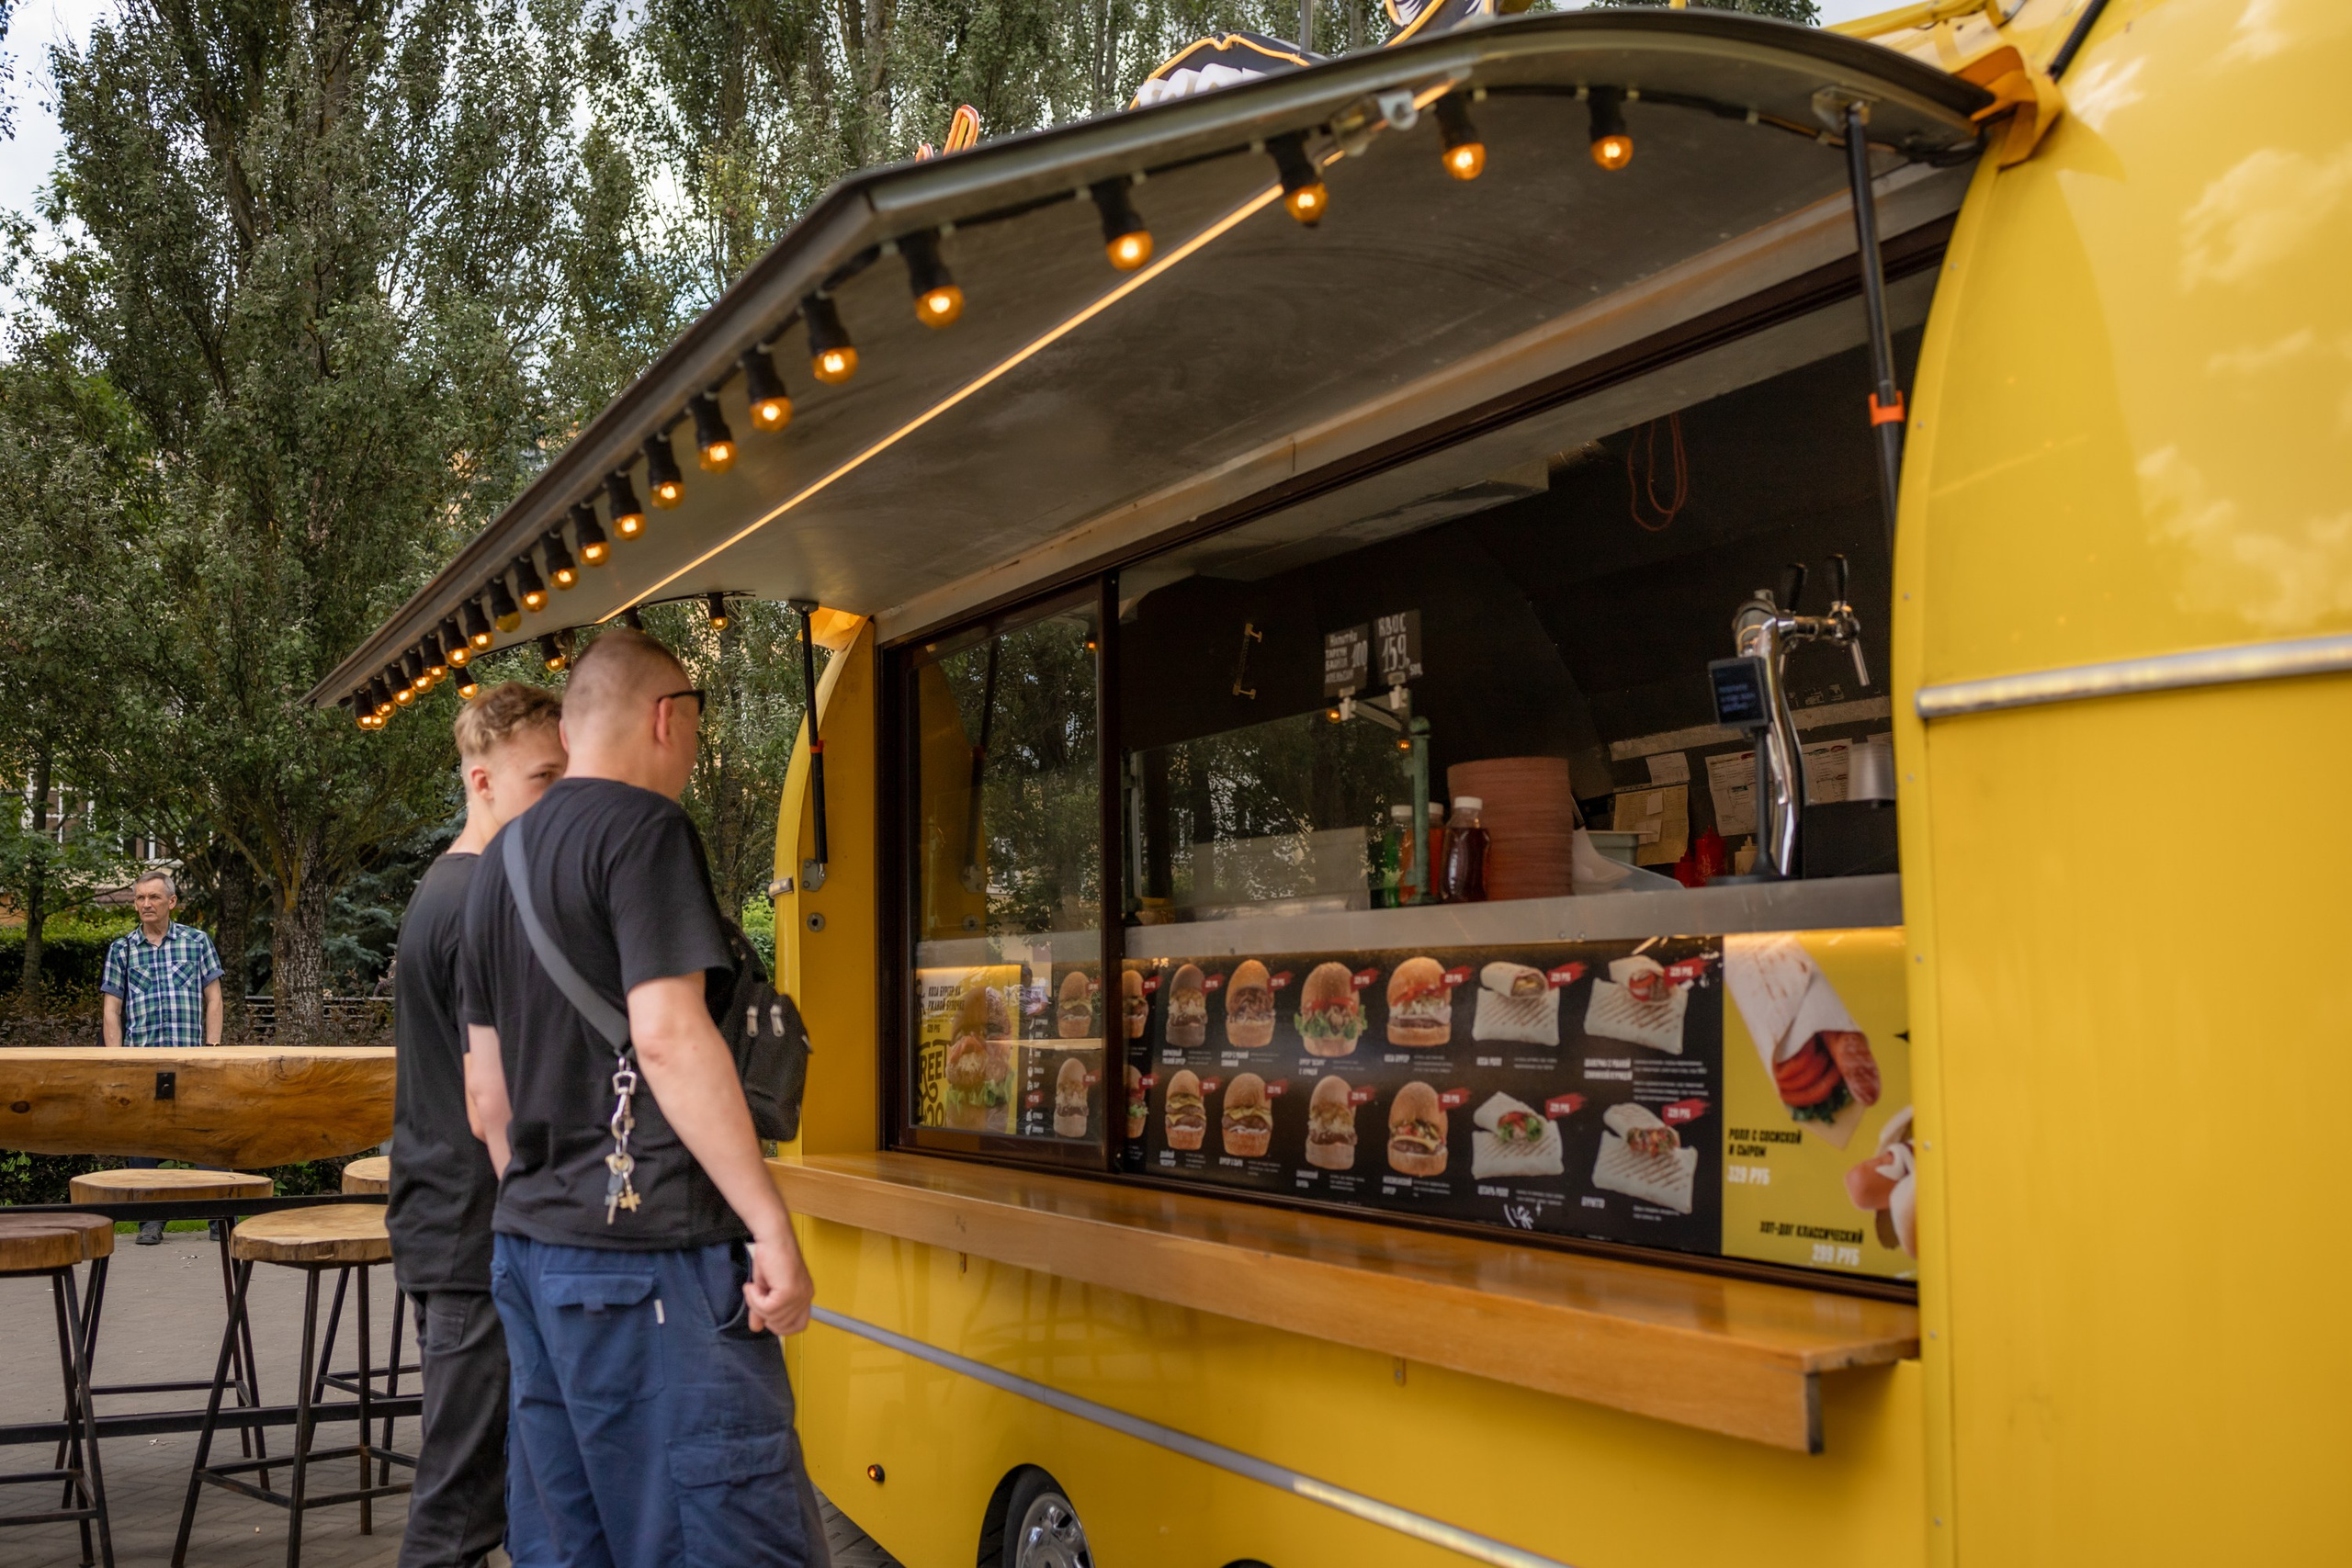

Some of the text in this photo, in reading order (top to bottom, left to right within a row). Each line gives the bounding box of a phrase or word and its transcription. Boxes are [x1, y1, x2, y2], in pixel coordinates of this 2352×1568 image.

[1729, 1128, 1802, 1144] РОЛЛ С СОСИСКОЙ
[1729, 1144, 1766, 1157] И СЫРОМ
[1749, 1166, 1770, 1186] РУБ
[1760, 1221, 1864, 1244] ХОТ-ДОГ КЛАССИЧЕСКИЙ
[1838, 1247, 1860, 1267] РУБ
